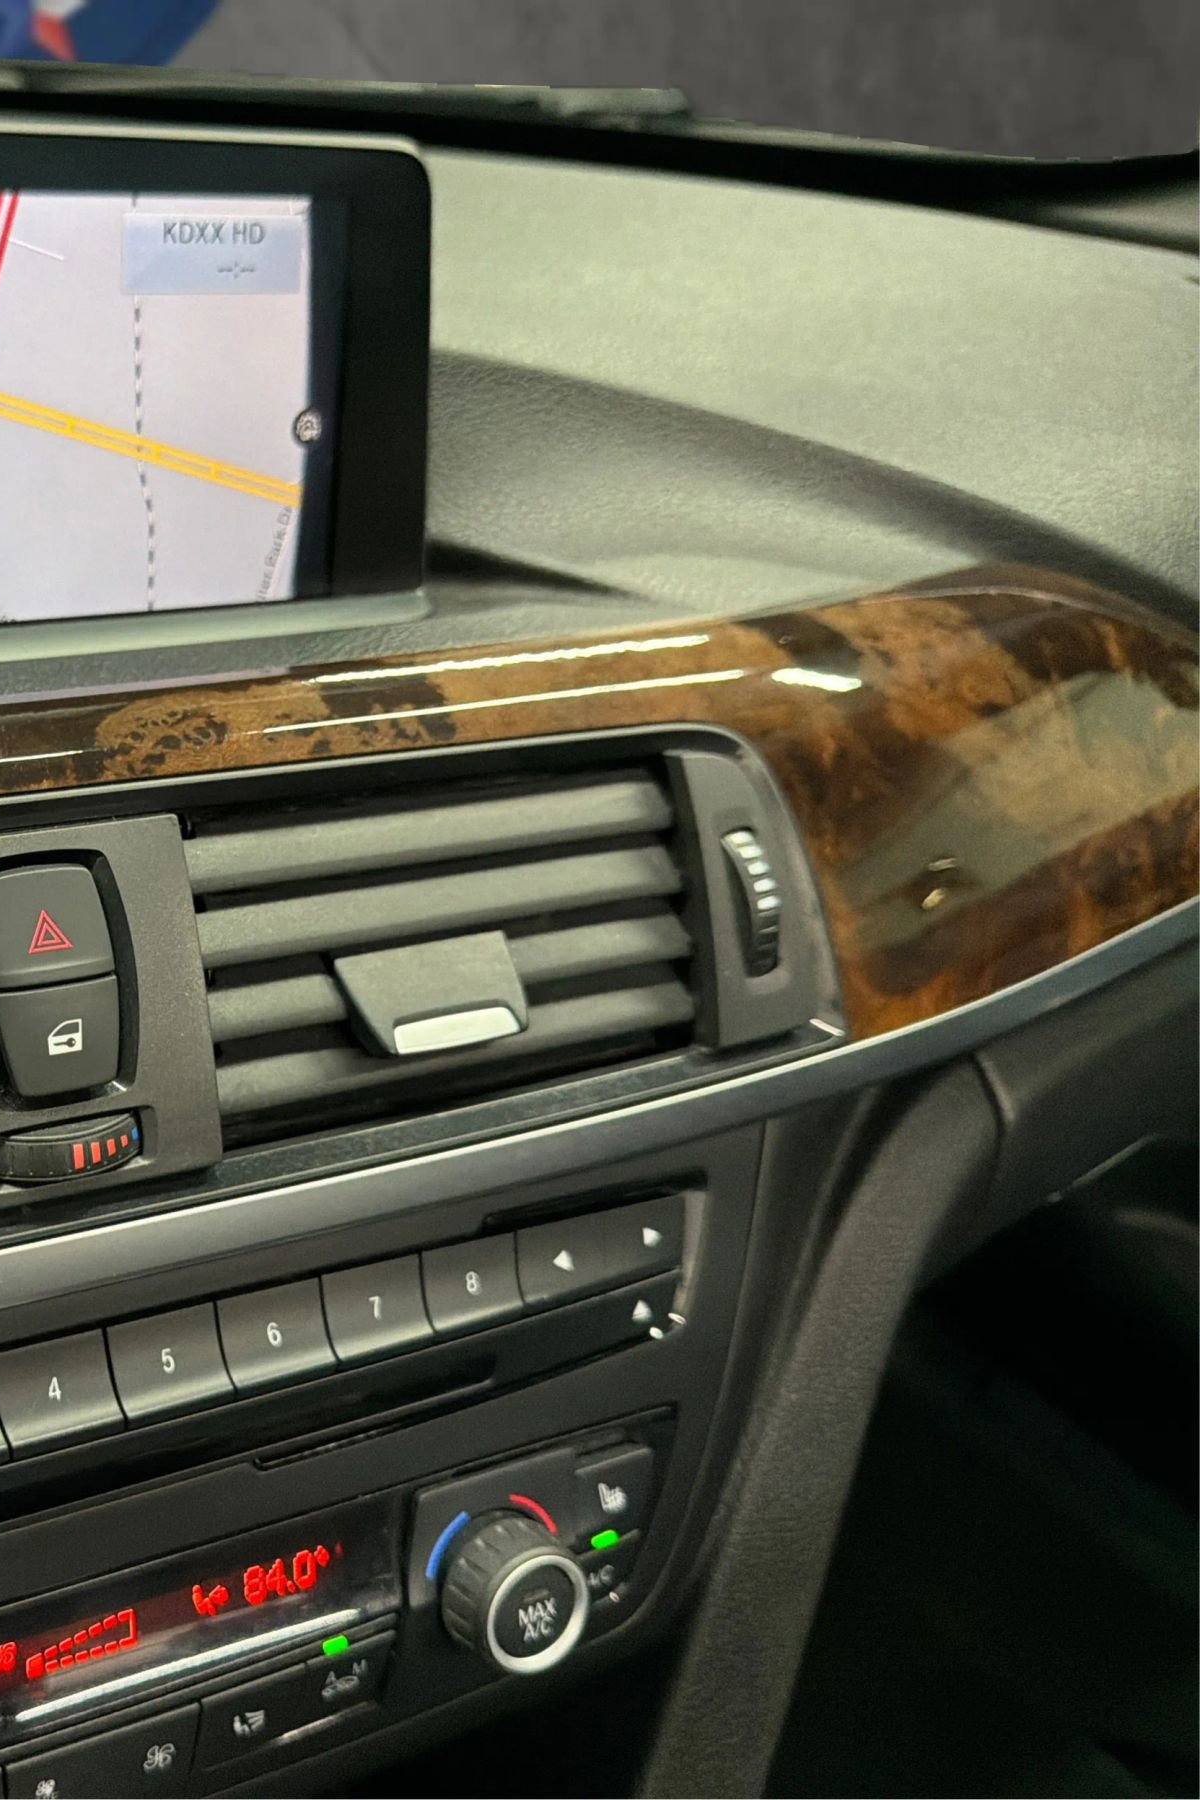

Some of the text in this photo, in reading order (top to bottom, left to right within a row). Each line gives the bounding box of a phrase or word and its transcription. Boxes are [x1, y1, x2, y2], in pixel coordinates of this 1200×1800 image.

[162, 222, 266, 245] KDXX HD
[465, 1271, 482, 1295] 8
[368, 1295, 382, 1320] 7
[266, 1321, 283, 1348] 6
[161, 1347, 176, 1374] 5
[48, 1376, 63, 1402] 4
[517, 1597, 558, 1627] MAX
[523, 1617, 554, 1642] A/C
